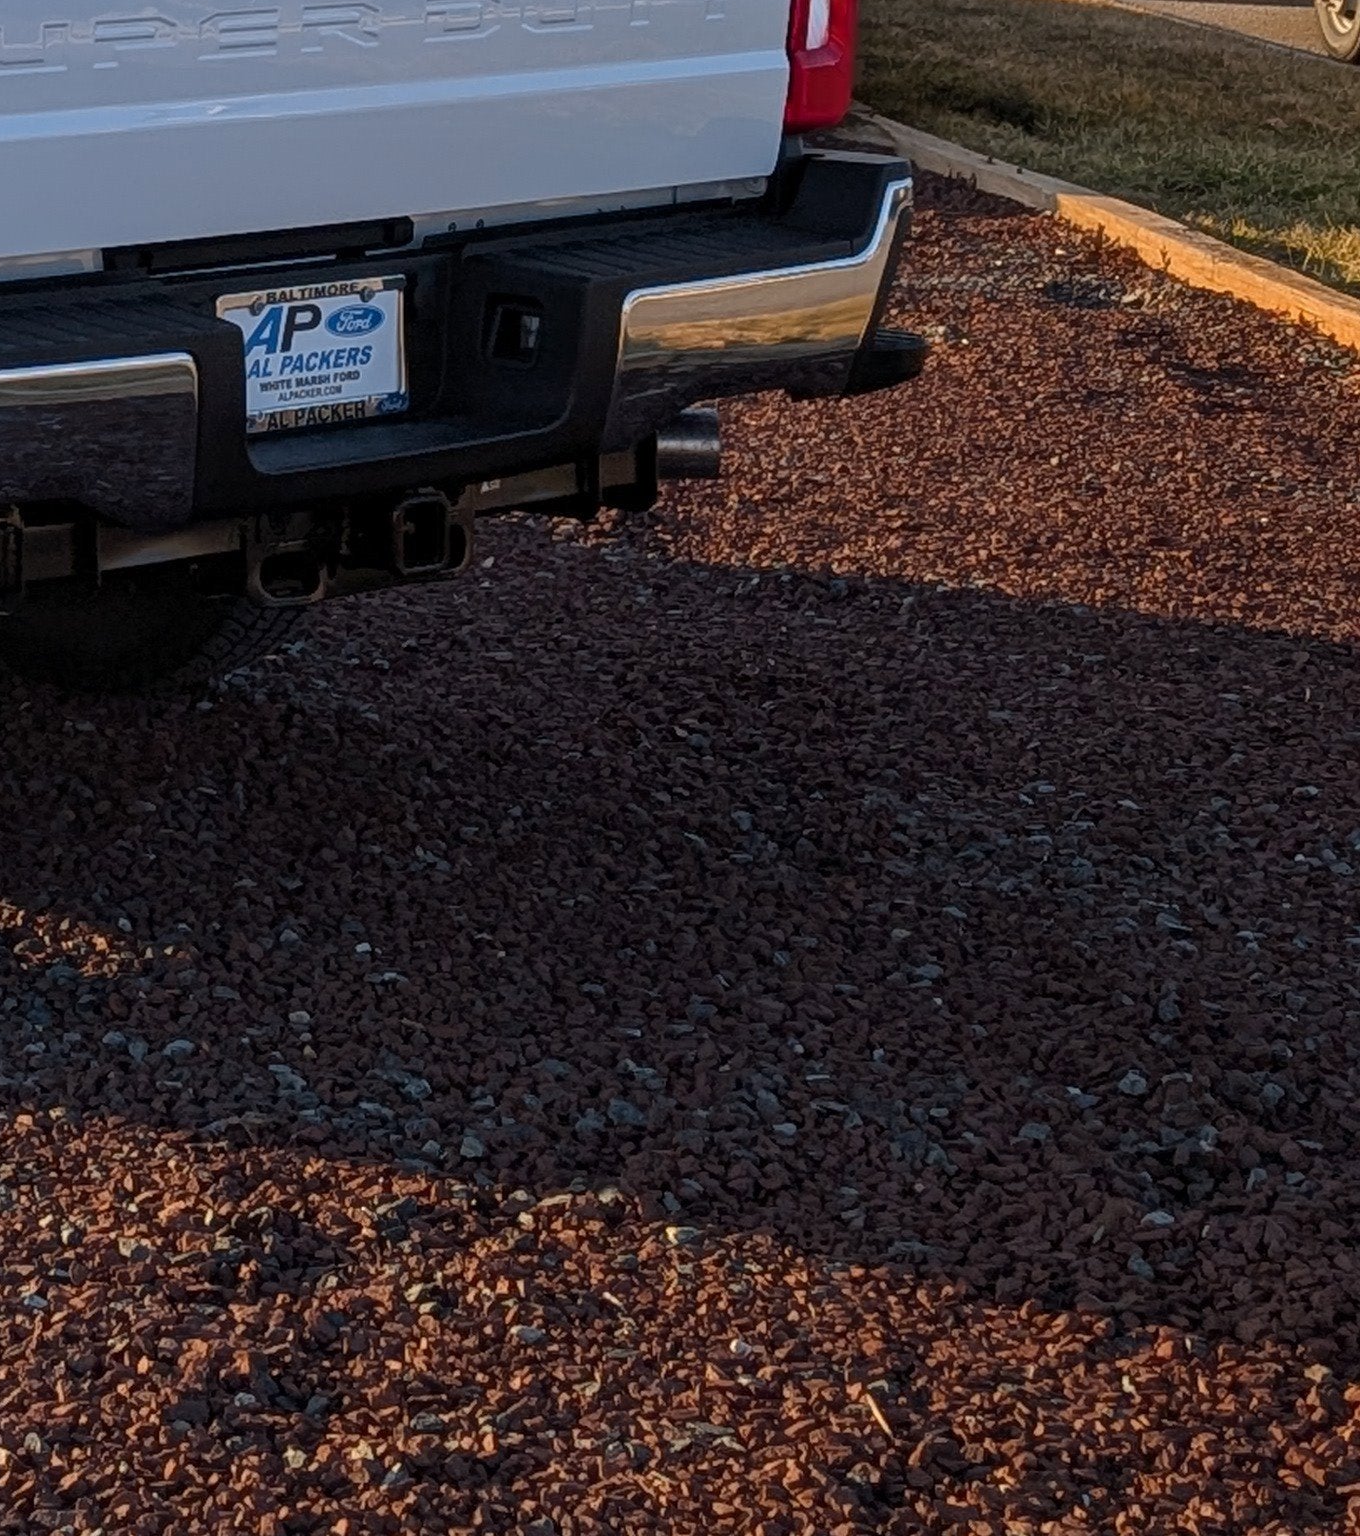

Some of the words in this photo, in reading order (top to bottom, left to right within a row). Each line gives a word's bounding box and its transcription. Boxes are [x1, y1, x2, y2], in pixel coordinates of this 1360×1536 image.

[266, 283, 359, 303] BALTIMORE
[245, 304, 322, 356] AP
[336, 308, 373, 332] Ford
[247, 357, 273, 379] AL
[279, 345, 373, 375] PACKERS
[259, 378, 292, 393] WHITE
[294, 372, 331, 388] MARSH
[333, 369, 360, 383] FORD
[278, 384, 343, 402] ALPACKER.COM
[266, 409, 290, 432] AL
[294, 399, 367, 428] PACKER
